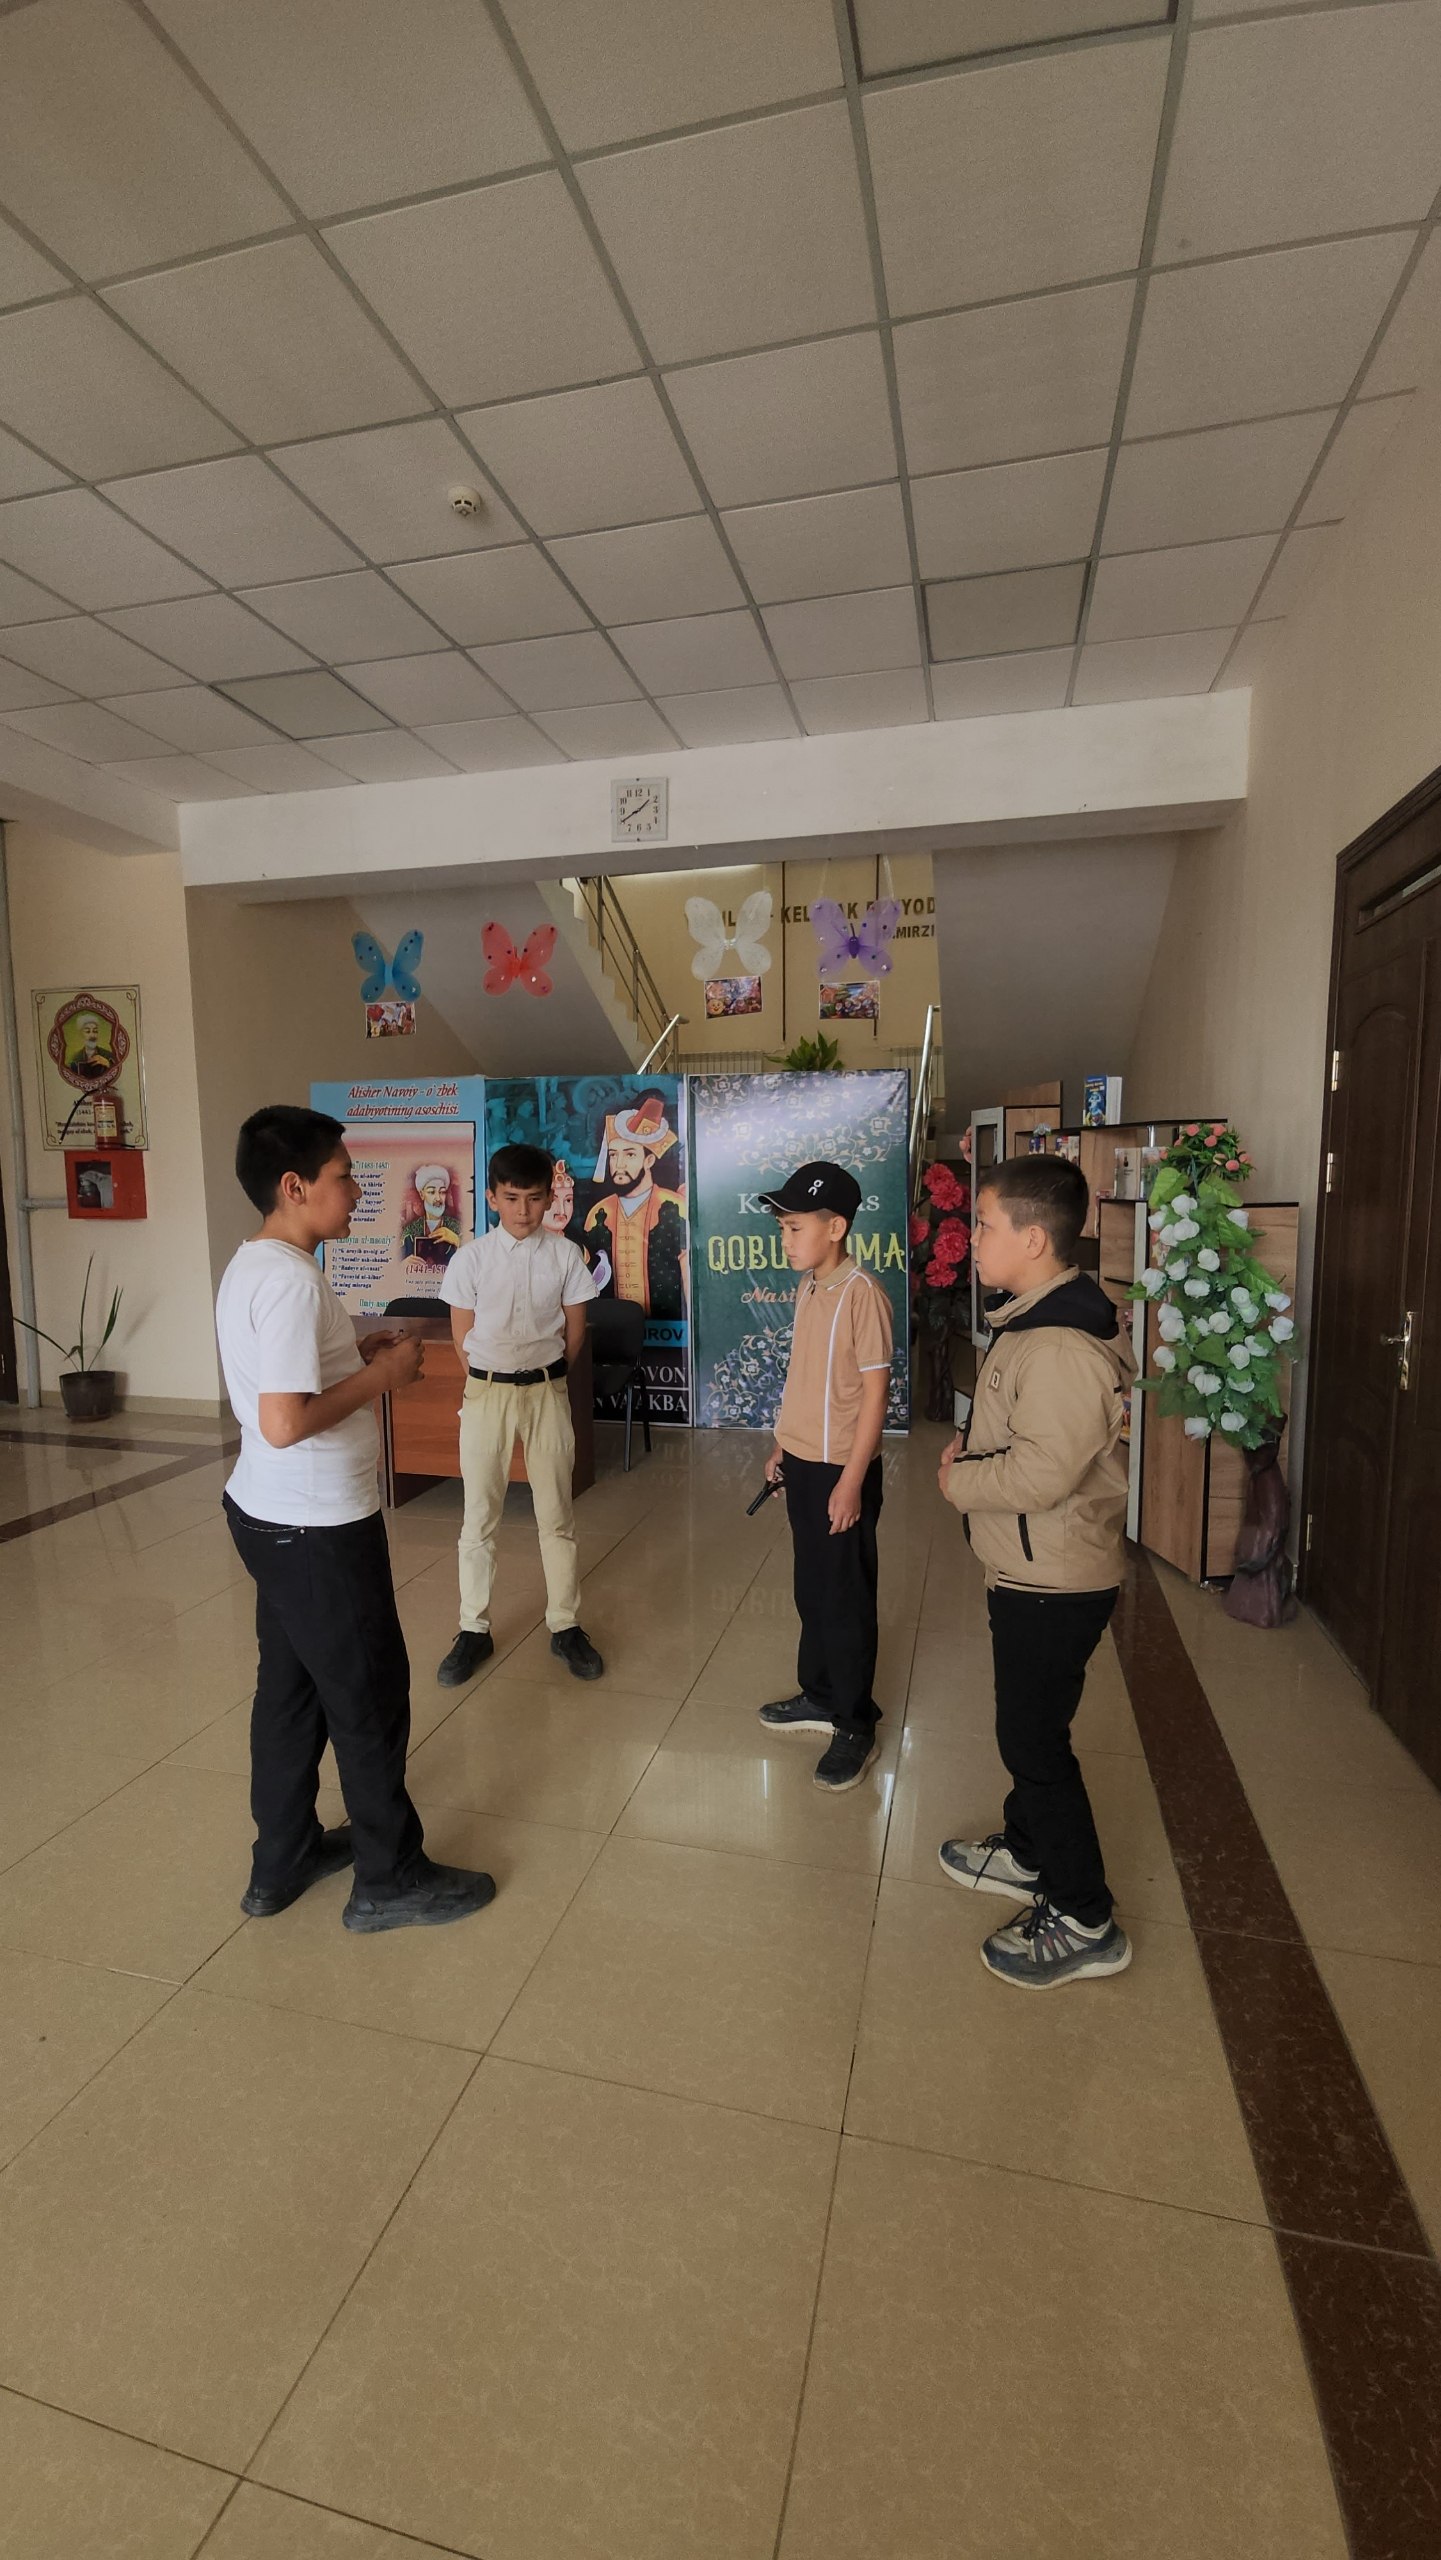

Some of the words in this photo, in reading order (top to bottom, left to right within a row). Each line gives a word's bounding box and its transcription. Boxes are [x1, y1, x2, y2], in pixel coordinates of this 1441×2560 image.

[348, 1085, 381, 1099] Alisher
[383, 1086, 418, 1101] Navoiy
[347, 1103, 413, 1119] adabiyotining
[708, 1232, 907, 1274] QOBUMA
[406, 1264, 446, 1275] (1441-150
[740, 1287, 796, 1304] Nasi
[644, 1328, 684, 1341] IROV
